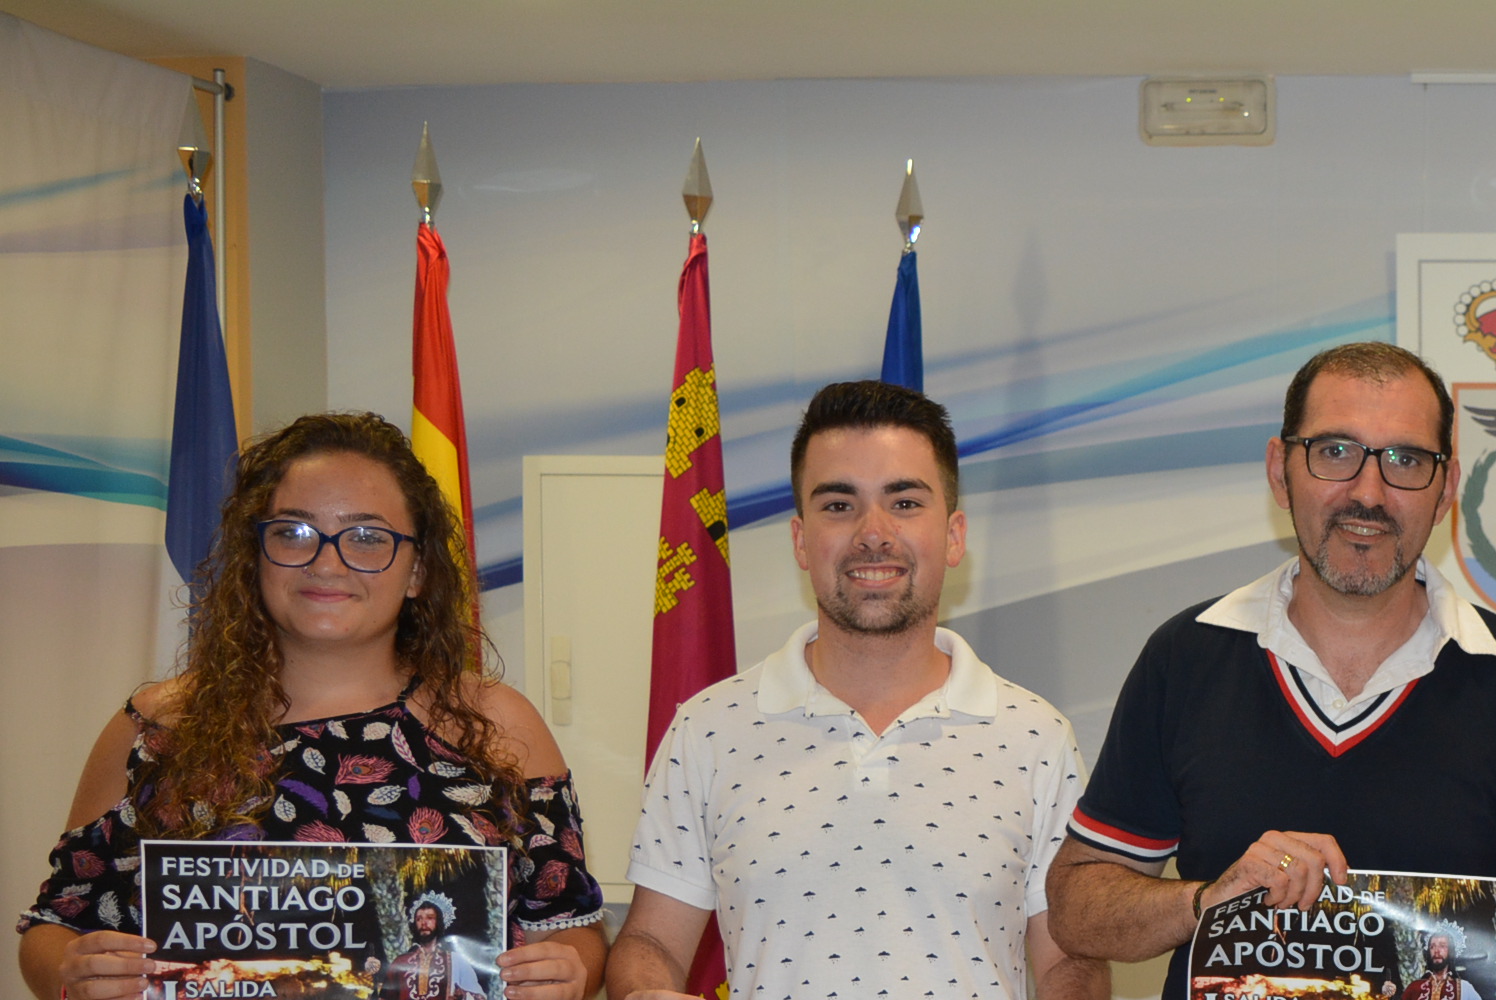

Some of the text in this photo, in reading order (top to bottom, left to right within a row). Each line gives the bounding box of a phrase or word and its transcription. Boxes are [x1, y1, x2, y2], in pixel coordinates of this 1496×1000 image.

[162, 857, 365, 878] FESTIVIDAD DE
[162, 883, 365, 910] SANTIAGO
[1360, 891, 1385, 904] DE
[162, 914, 367, 950] APÓSTOL
[1208, 909, 1385, 938] SANTIAGO
[1205, 934, 1384, 972] APÓSTOL
[185, 981, 276, 998] SALIDA
